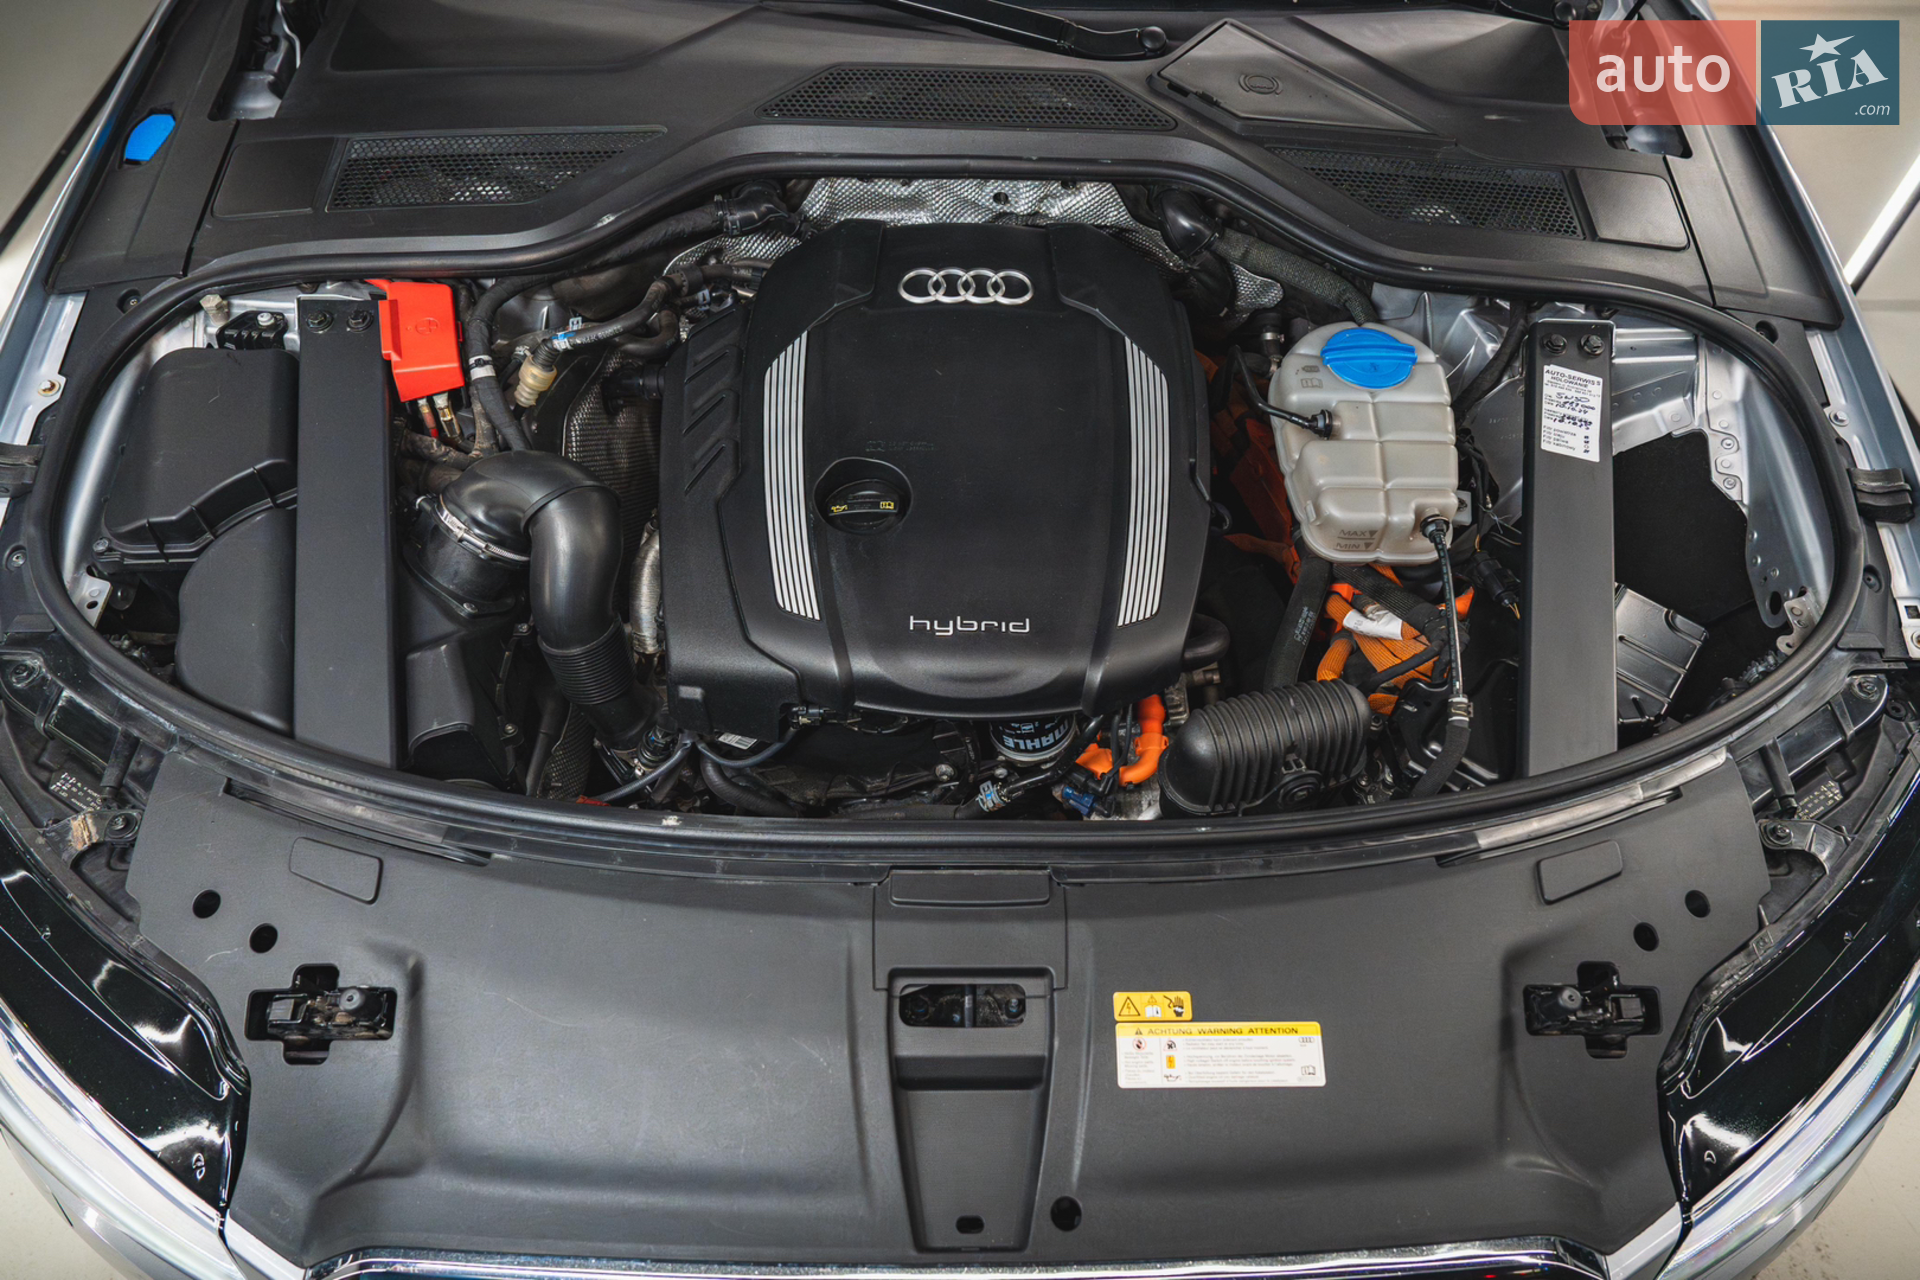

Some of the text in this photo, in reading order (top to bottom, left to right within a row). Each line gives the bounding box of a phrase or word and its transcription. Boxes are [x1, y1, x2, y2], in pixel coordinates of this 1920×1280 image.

[1338, 529, 1367, 537] MAX
[1335, 542, 1360, 550] MIN
[909, 615, 1030, 636] hybrid
[1002, 719, 1069, 751] MAHLE
[1197, 1027, 1243, 1035] WARNING
